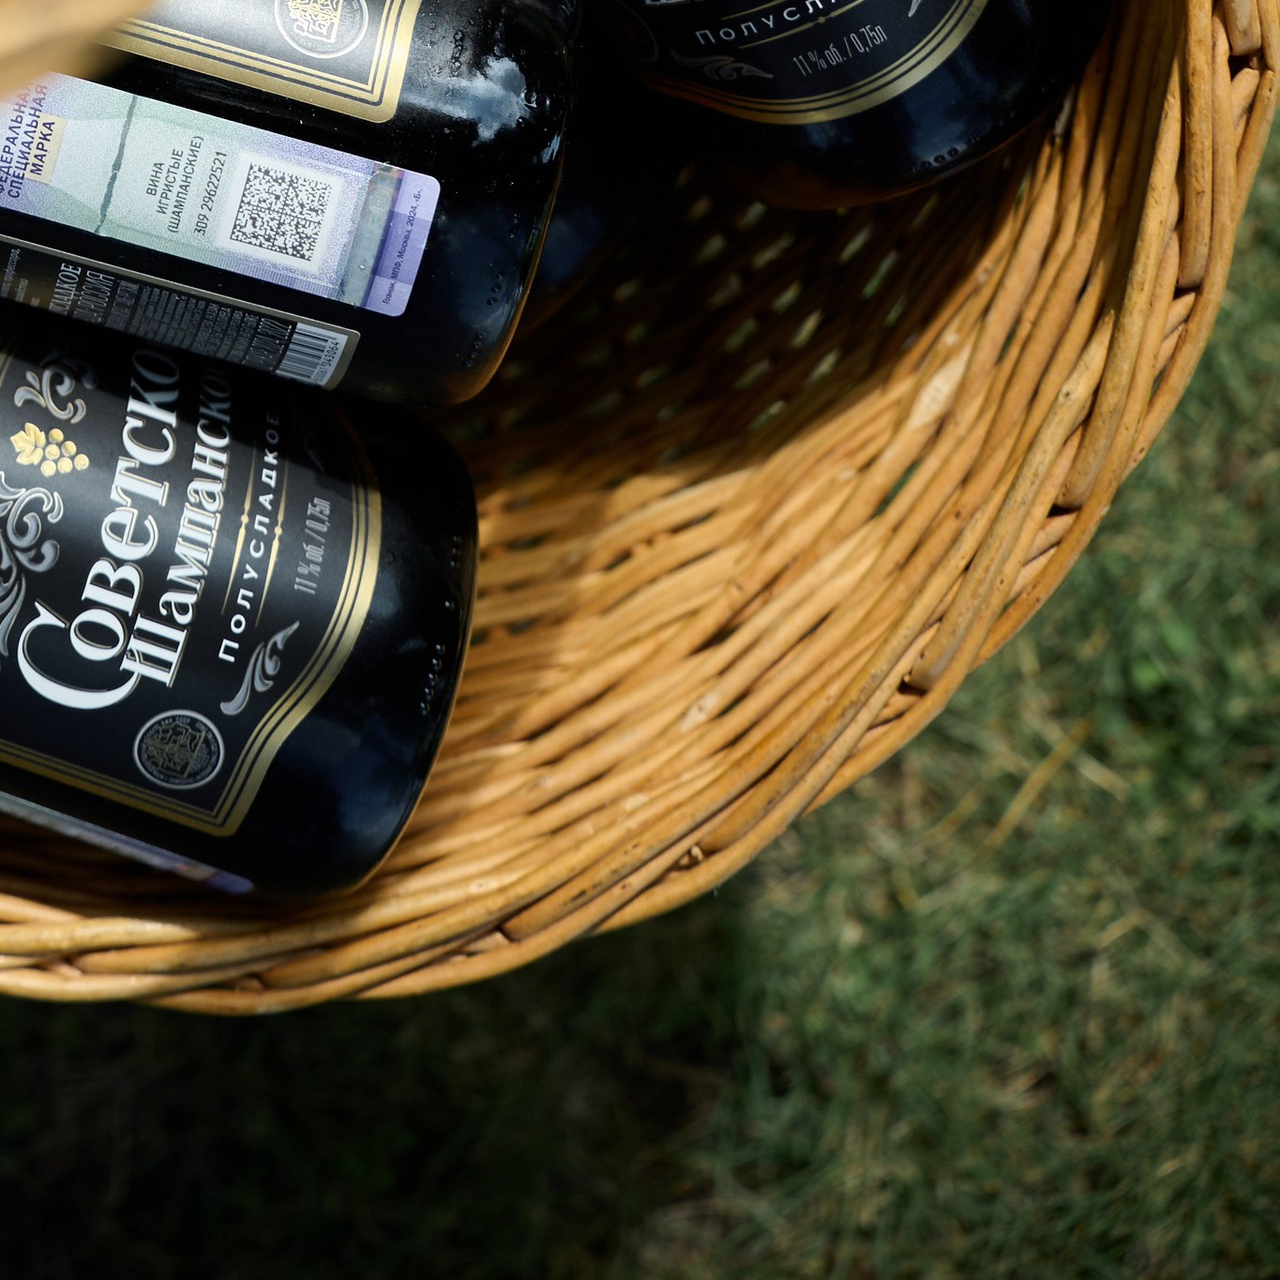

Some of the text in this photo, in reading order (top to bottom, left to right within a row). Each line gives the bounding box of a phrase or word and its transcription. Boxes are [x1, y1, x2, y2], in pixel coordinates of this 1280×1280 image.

[793, 56, 807, 77] 11
[809, 49, 827, 71] %
[825, 42, 847, 66] об.
[850, 24, 888, 54] 0,75л
[8, 84, 49, 199] СПЕЦИАЛЬНАЯ
[30, 120, 55, 177] МАРКА
[146, 162, 165, 196] ВИНА
[156, 148, 184, 215] ИГРИСТЫЕ
[167, 135, 204, 233] (ШАМПАНСКИЕ)
[193, 150, 228, 236] 309 29622521
[397, 227, 413, 261] Москва,
[405, 203, 420, 228] 2024,
[17, 347, 182, 709] Советско
[120, 369, 232, 688] Шампанско
[218, 411, 281, 663] ПОЛУСЛАДКОЕ
[294, 579, 317, 595] 11
